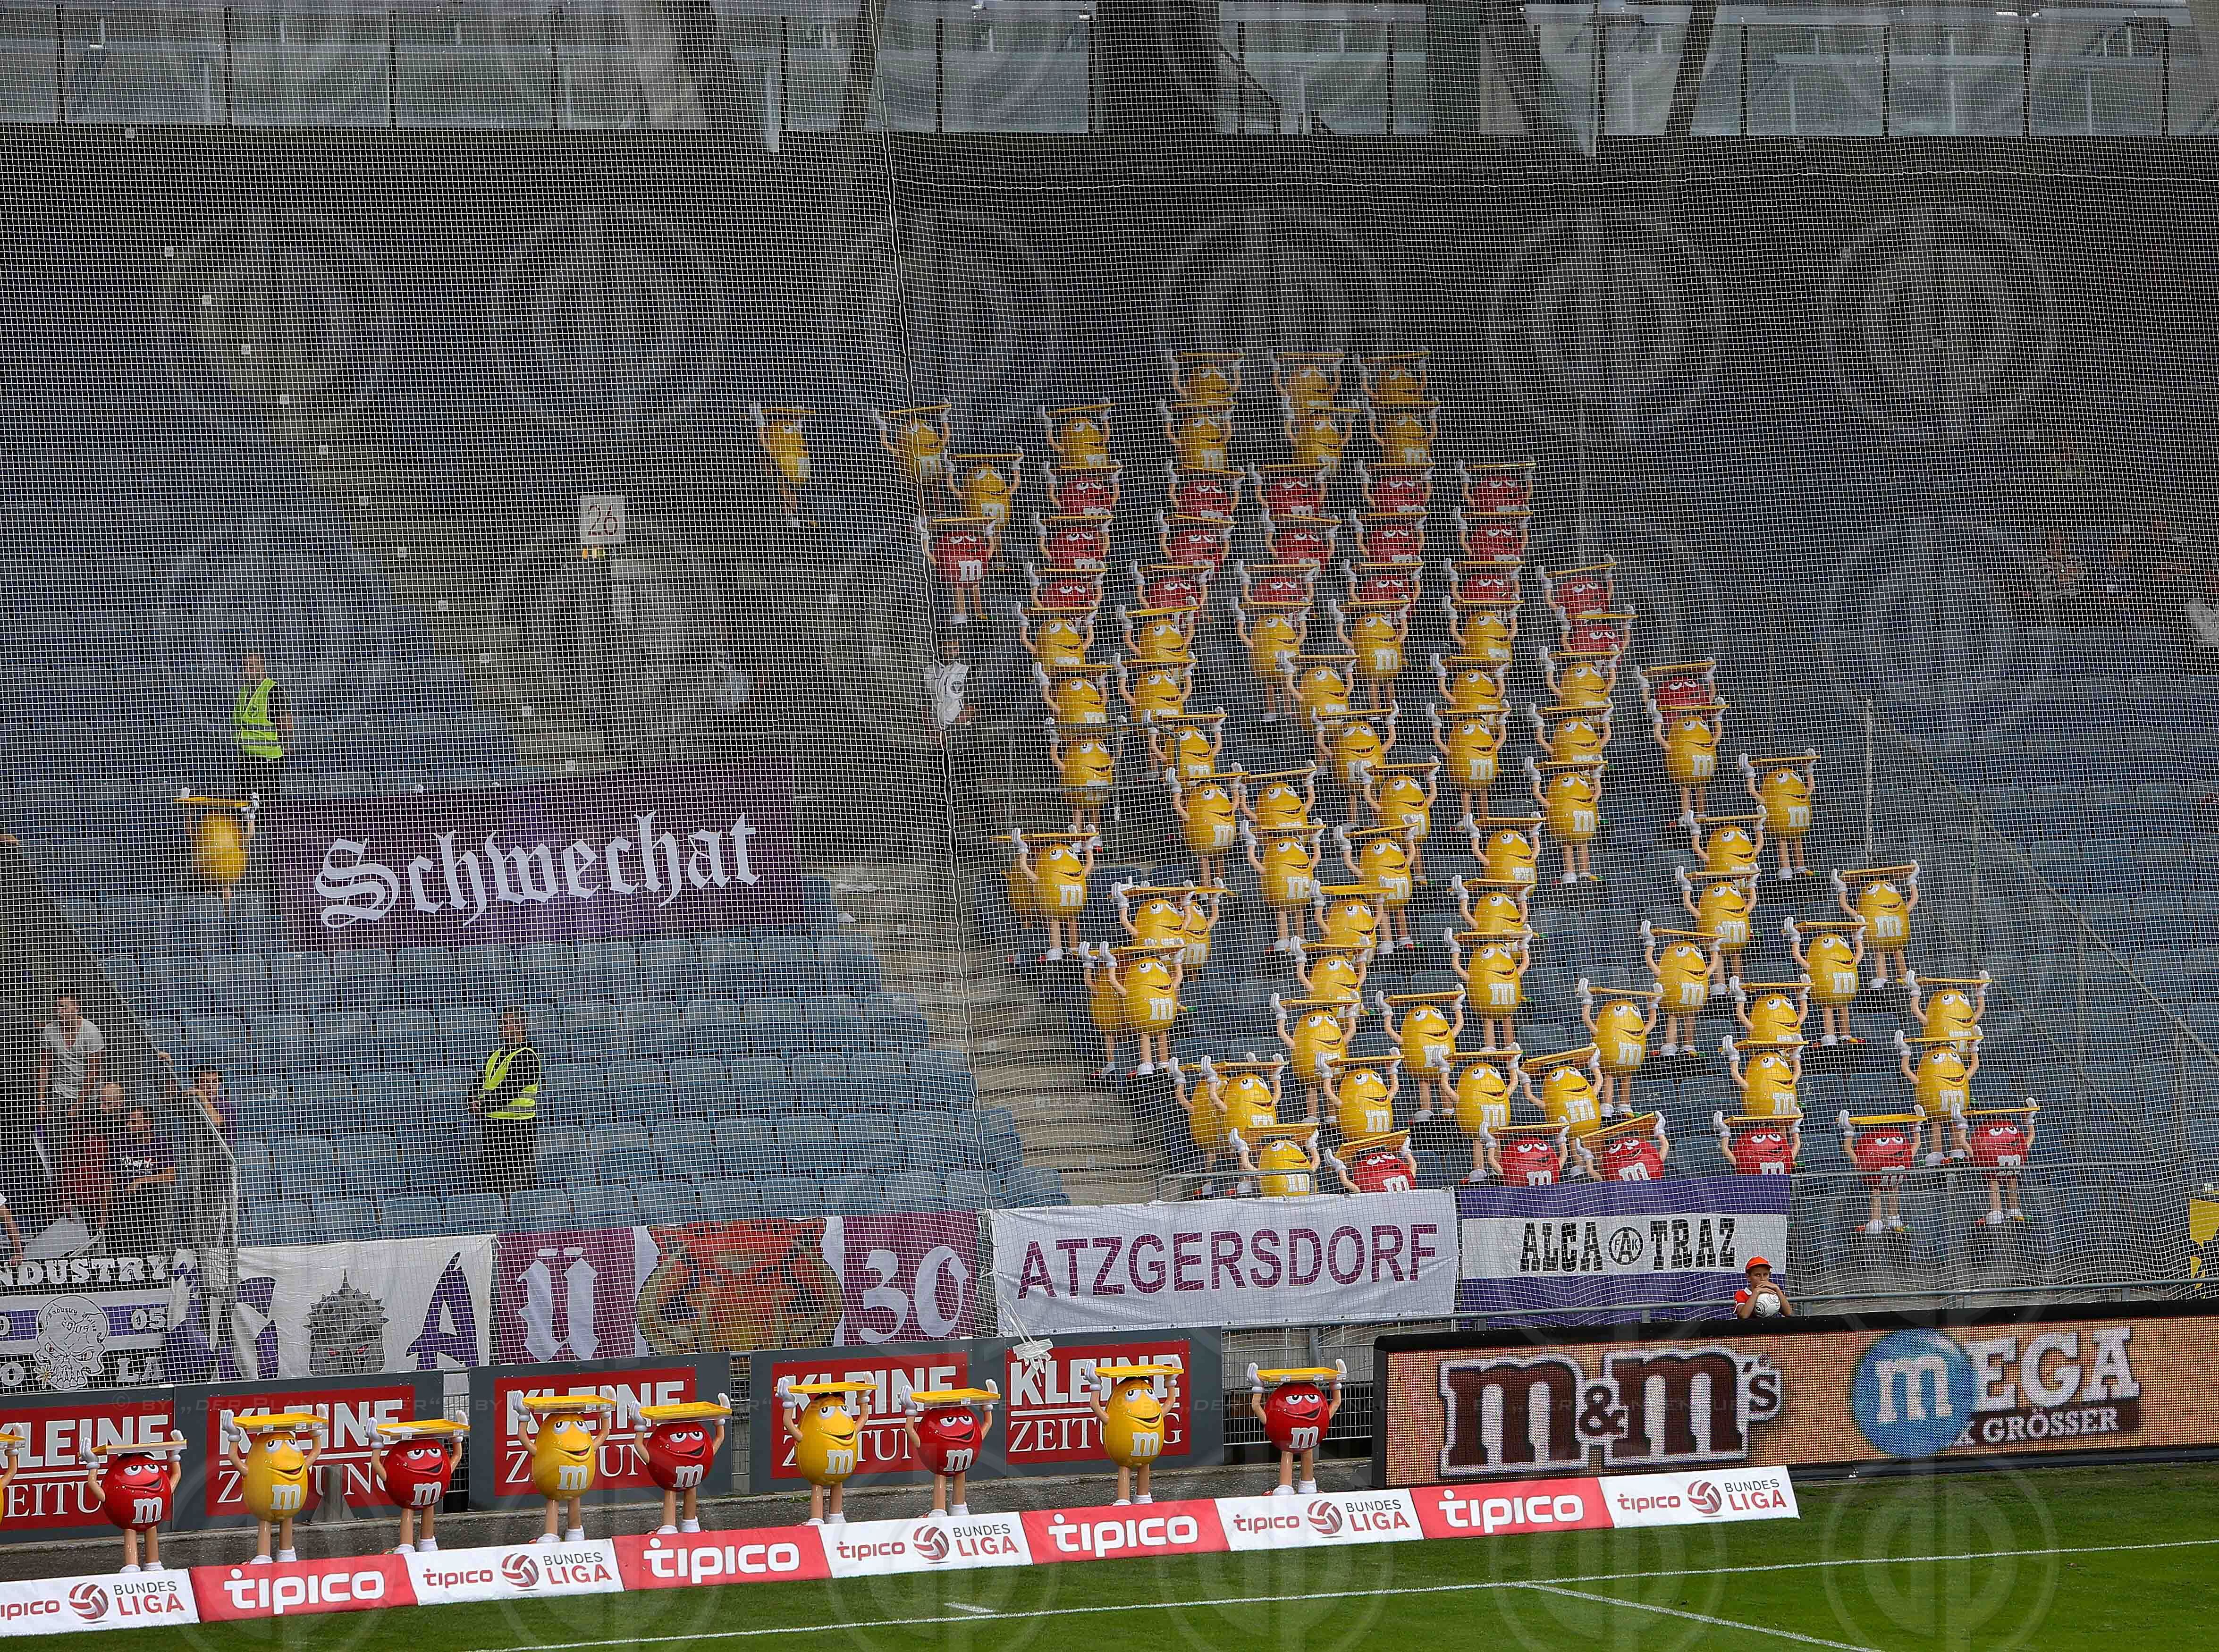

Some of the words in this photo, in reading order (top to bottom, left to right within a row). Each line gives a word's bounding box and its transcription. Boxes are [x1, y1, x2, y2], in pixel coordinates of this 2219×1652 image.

[588, 504, 618, 535] 26
[959, 560, 982, 581] m
[1375, 649, 1398, 670] m
[1470, 759, 1493, 780] m
[1692, 755, 1715, 776] m
[1573, 810, 1597, 832] m
[1788, 806, 1810, 827] m
[1214, 825, 1233, 846] m
[314, 811, 762, 929] Schwechat
[1059, 885, 1083, 906] m
[1875, 916, 1902, 937] m
[1186, 944, 1207, 964] m
[1490, 983, 1515, 1004] m
[1681, 982, 1704, 1005] m
[1833, 972, 1856, 994] m
[1149, 998, 1173, 1020] m
[1617, 1043, 1642, 1065] m
[1566, 1098, 1595, 1123] m
[1772, 1092, 1795, 1114] m
[1940, 1090, 1964, 1112] m
[1366, 1110, 1390, 1132] m
[1481, 1104, 1506, 1127] m
[1520, 1221, 1603, 1273] ALCA
[1650, 1218, 1736, 1270] TRAZ
[1016, 1223, 1438, 1299] ATZGERSDORF
[859, 1245, 969, 1344] 30
[1982, 1407, 2118, 1444] GRÖSSER
[1131, 1432, 1159, 1457] m
[1289, 1426, 1319, 1449] m
[825, 1449, 853, 1474] m
[943, 1447, 974, 1472] m
[557, 1465, 588, 1490] m
[673, 1464, 704, 1488] m
[1724, 1479, 1779, 1492] BUNDES
[271, 1484, 301, 1510] m
[411, 1481, 442, 1506] m
[1617, 1494, 1680, 1512] tipico
[1729, 1490, 1787, 1511] LIGA
[132, 1497, 162, 1524] m
[1345, 1499, 1401, 1513] BUNDES
[1438, 1490, 1584, 1534] tipico
[953, 1524, 1011, 1537] BUNDES
[1232, 1514, 1300, 1534] tipico
[1350, 1511, 1410, 1531] LIGA
[957, 1535, 1019, 1557] LIGA
[1048, 1514, 1198, 1558] tipico
[543, 1552, 603, 1566] BUNDES
[643, 1538, 800, 1584] tipico
[836, 1541, 905, 1561] tipico
[422, 1568, 493, 1589] tipico
[548, 1564, 612, 1585] LIGA
[113, 1581, 177, 1595] BUNDES
[224, 1568, 385, 1614] tipico
[0, 1598, 60, 1621] ipico
[117, 1593, 185, 1616] LIGA
